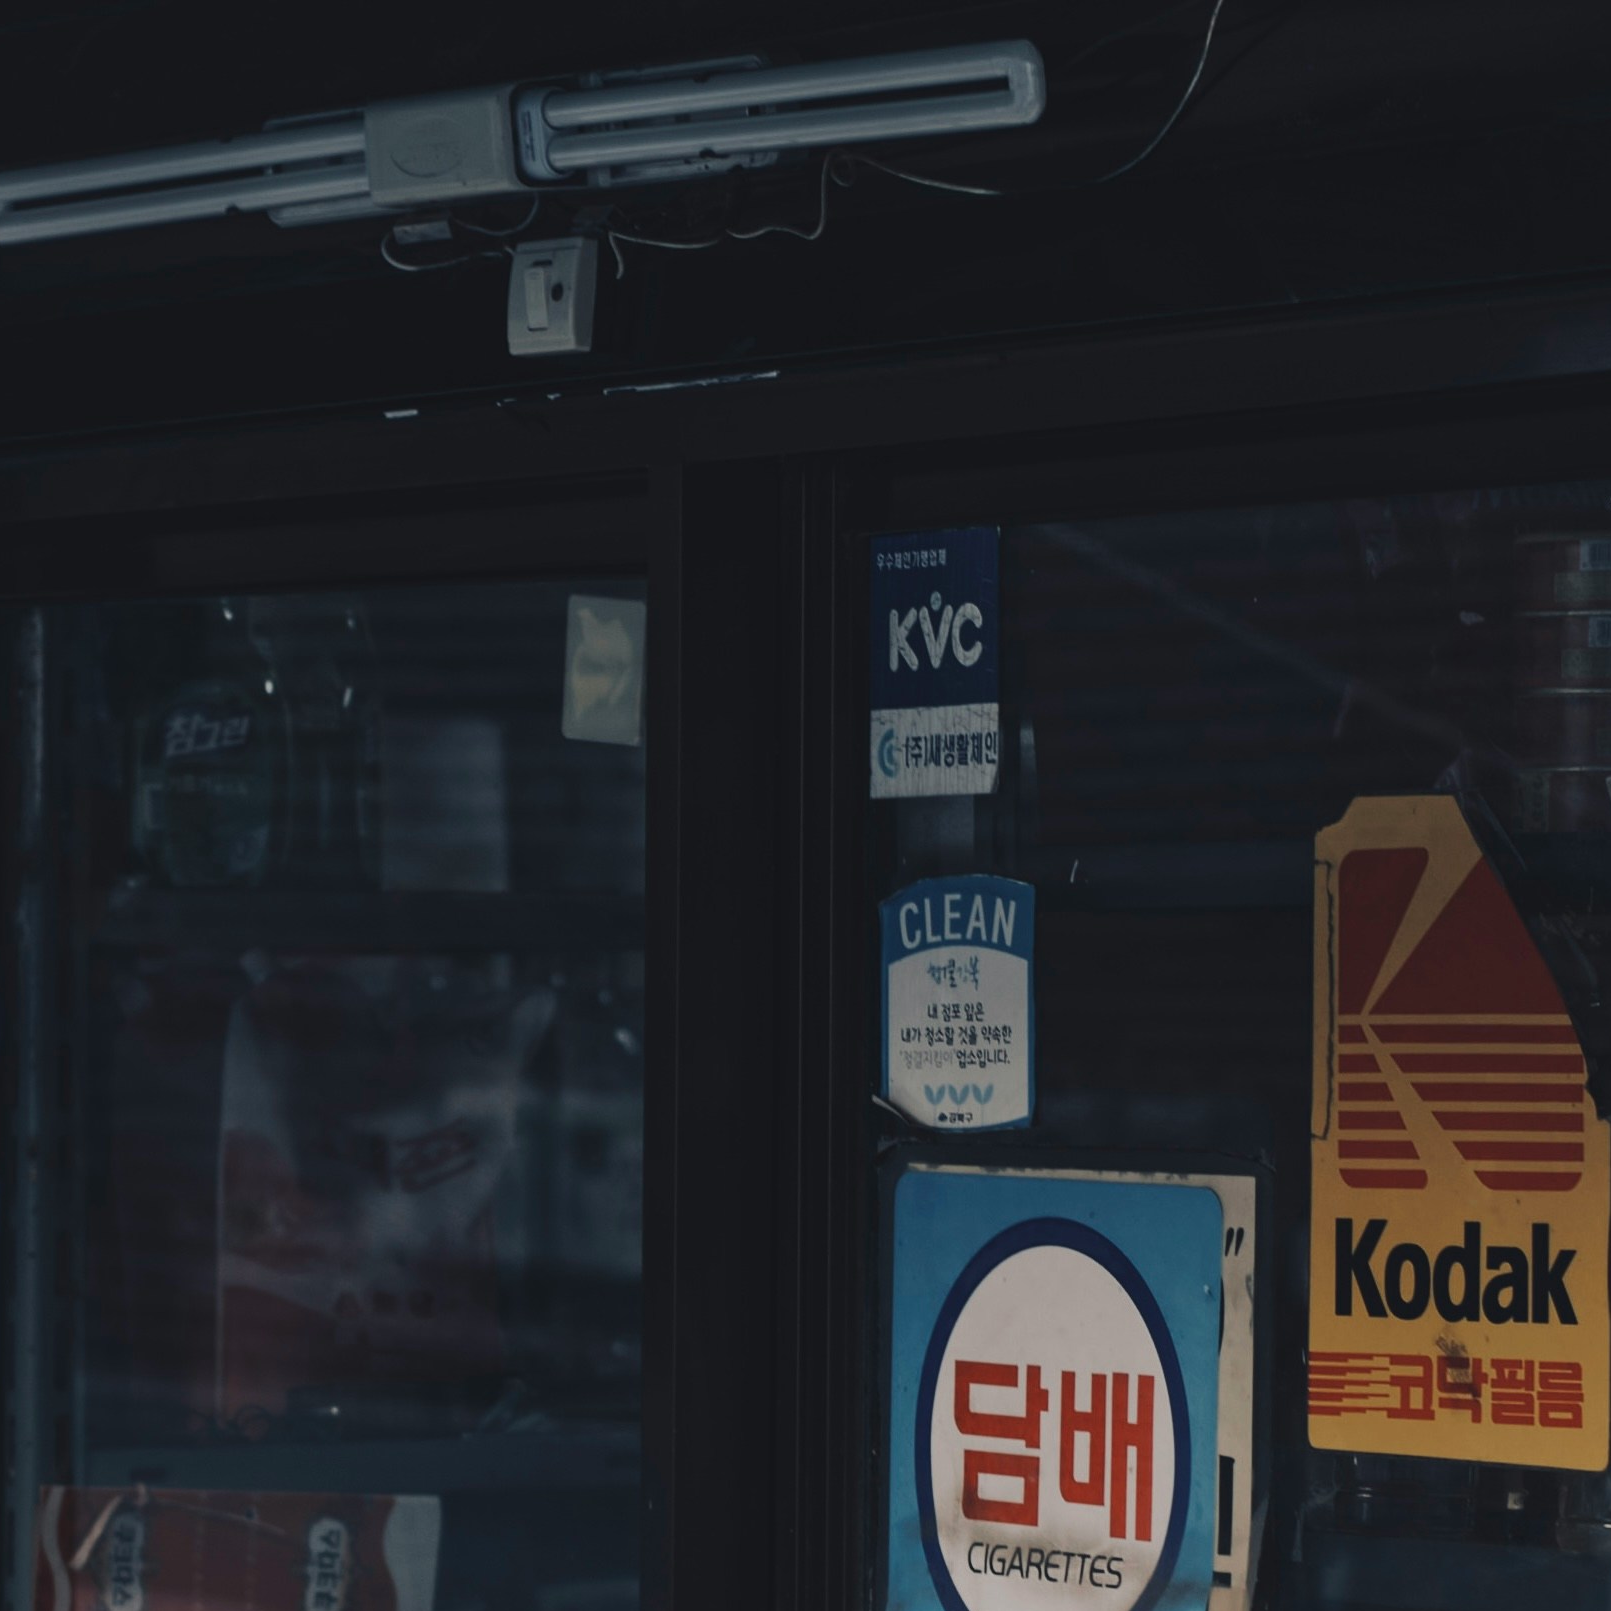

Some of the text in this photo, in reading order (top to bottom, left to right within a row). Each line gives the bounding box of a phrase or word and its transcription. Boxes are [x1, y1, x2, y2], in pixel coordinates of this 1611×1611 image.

[889, 600, 983, 673] KVC
[899, 892, 1016, 950] CLEAN
[900, 1025, 1012, 1046] 내가 청소할 것을 약속한
[927, 1003, 938, 1020] 내
[941, 1003, 962, 1022] 점포
[1334, 1216, 1579, 1327] Kodak
[1374, 1350, 1586, 1430] 코닥필름
[953, 1359, 1156, 1543] 담배
[313, 1529, 340, 1610] 쿠크다스
[967, 1540, 1124, 1590] CIGARETTES
